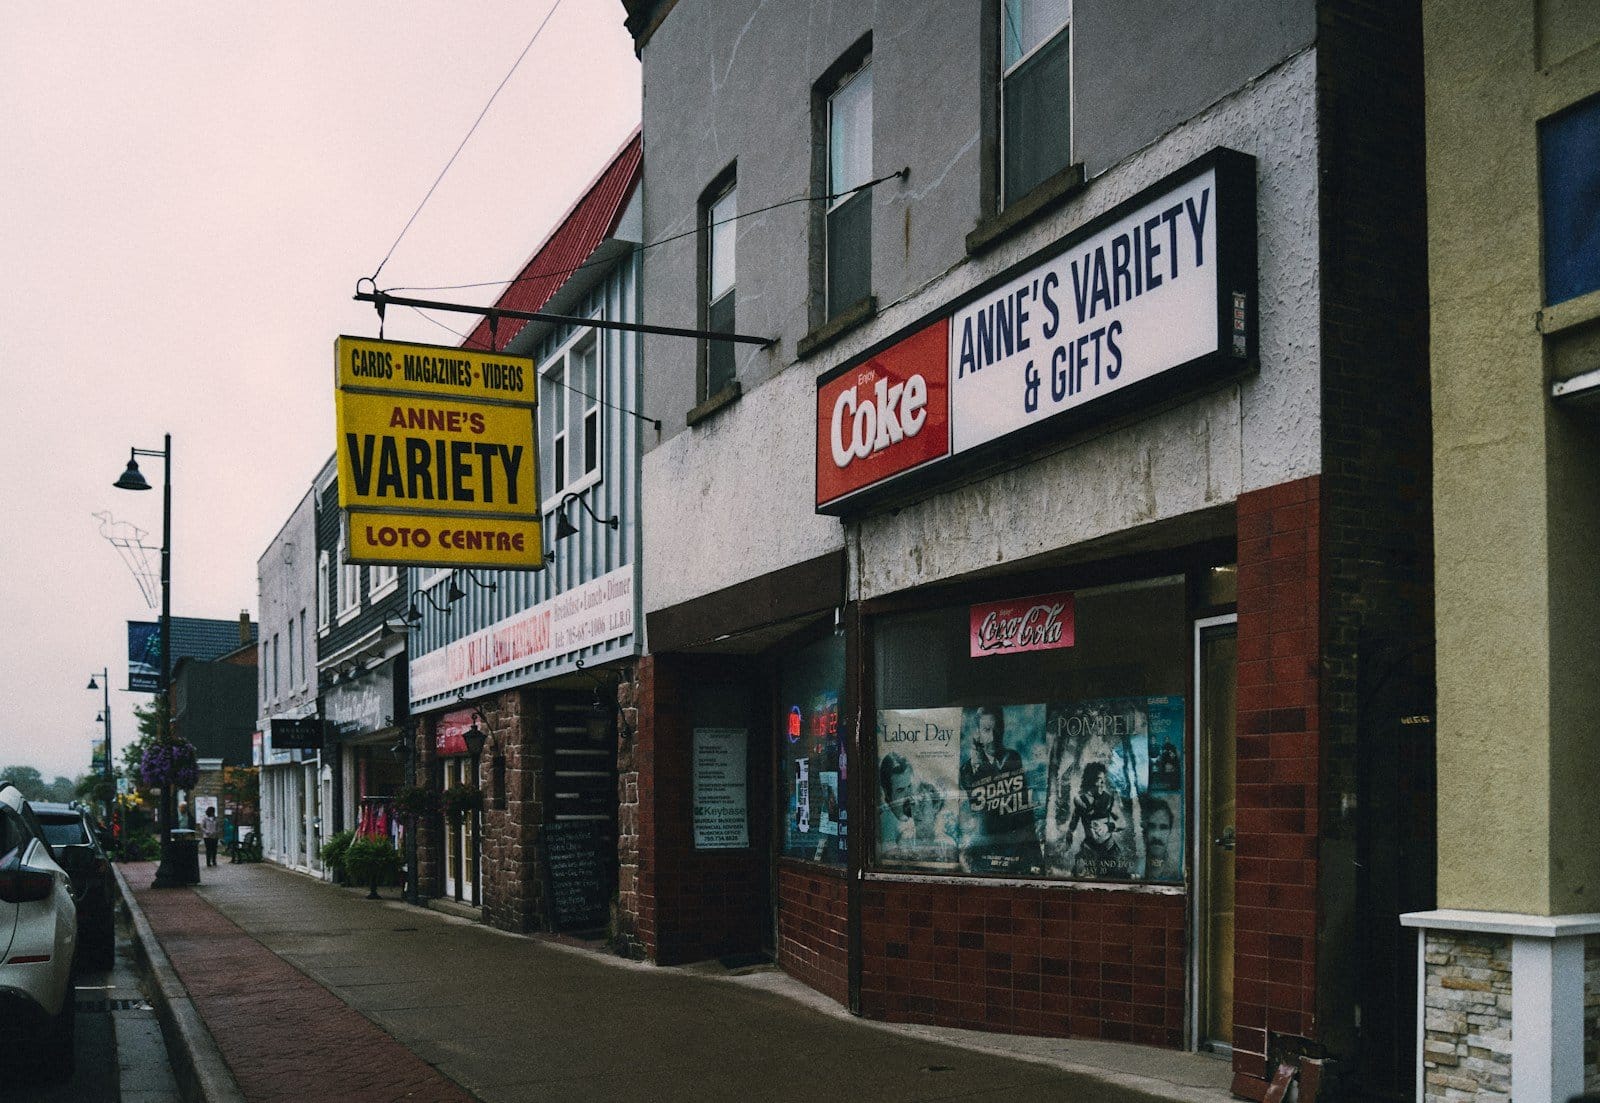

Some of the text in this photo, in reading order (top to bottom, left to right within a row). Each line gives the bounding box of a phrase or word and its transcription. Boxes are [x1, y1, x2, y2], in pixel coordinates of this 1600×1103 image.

[959, 271, 1060, 379] ANNE'S
[1070, 187, 1211, 325] VARIETY
[351, 348, 525, 393] CARDS MAGAZINES VIDEOS
[857, 370, 876, 386] Enjoy
[1025, 319, 1123, 413] & GIFTS
[389, 406, 486, 435] ANNE'S
[830, 373, 928, 468] Coke
[346, 432, 524, 505] VARIETY
[366, 526, 525, 552] LOTO CENTRE
[882, 722, 954, 747] Labor Day
[1056, 713, 1141, 737] POMPEII
[970, 786, 987, 812] 3
[986, 775, 1024, 800] DAYS
[987, 788, 1038, 816] TO KILL
[704, 806, 745, 818] Keybase
